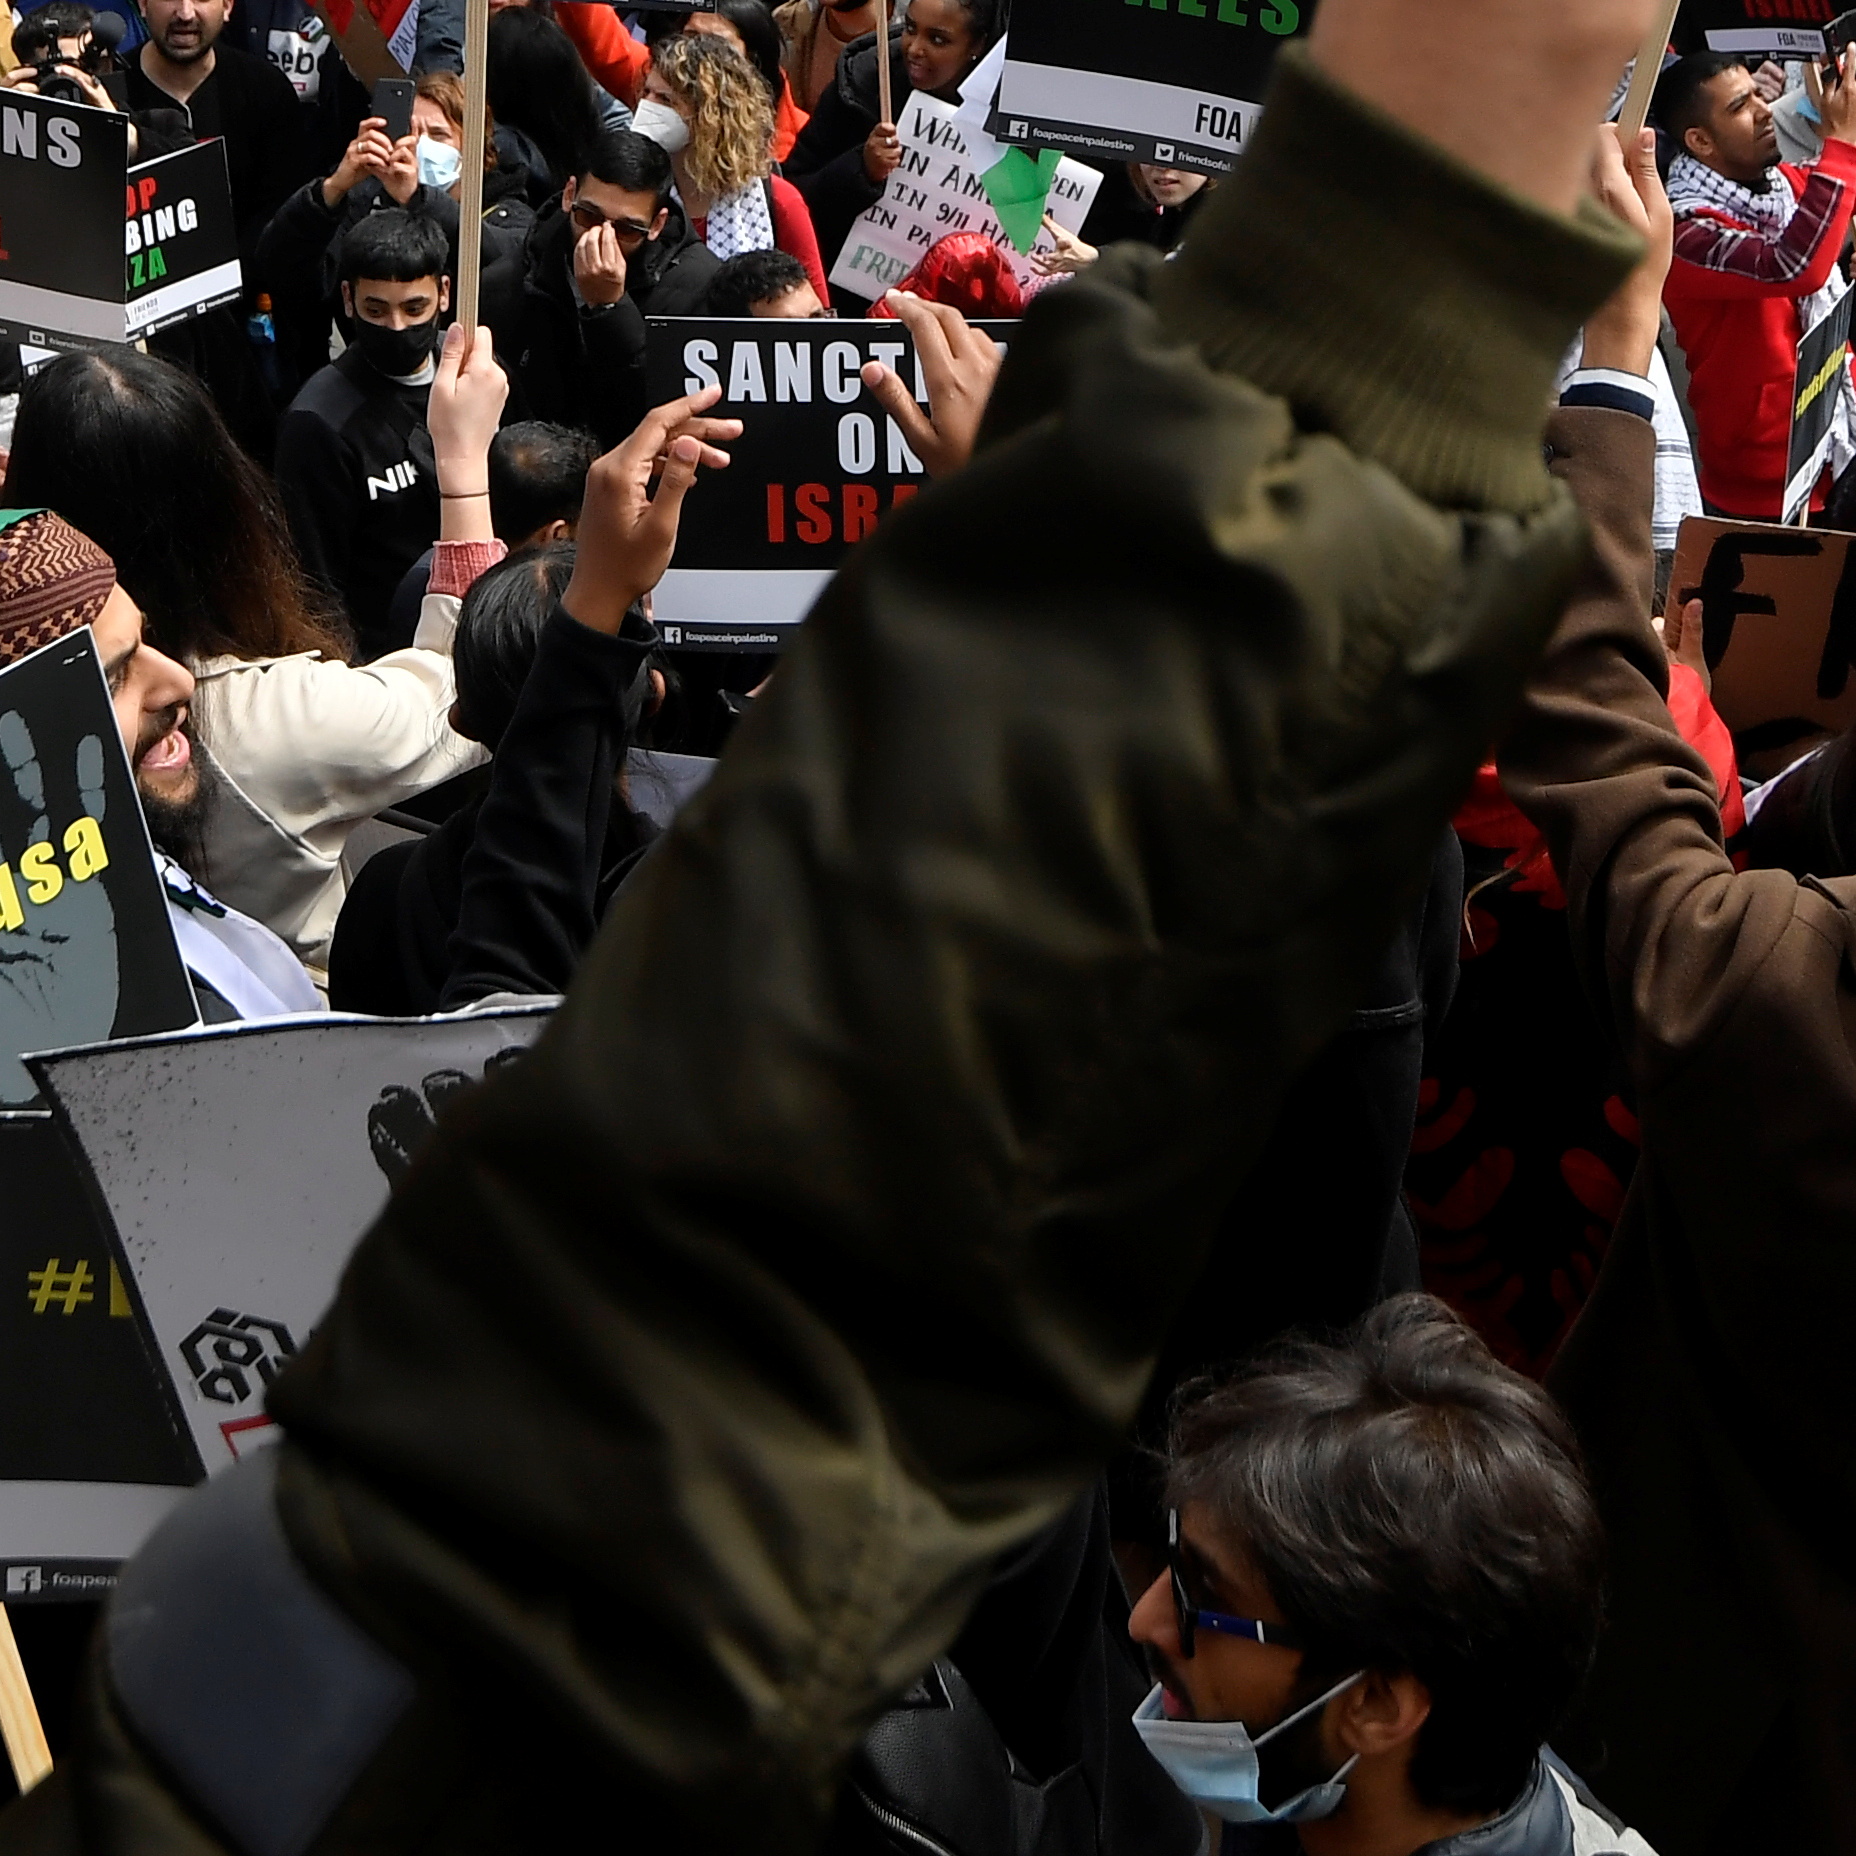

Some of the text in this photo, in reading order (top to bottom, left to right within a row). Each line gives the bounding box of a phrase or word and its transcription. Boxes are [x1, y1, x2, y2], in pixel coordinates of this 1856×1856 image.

[1032, 127, 1135, 154] foapeaceinpalestine
[1195, 103, 1241, 143] FOA
[894, 182, 970, 230] IN 9/11
[684, 339, 930, 403] SANCT
[838, 413, 924, 474] ON
[767, 483, 919, 543] ISR
[686, 632, 778, 644] foapeaceinpalestine
